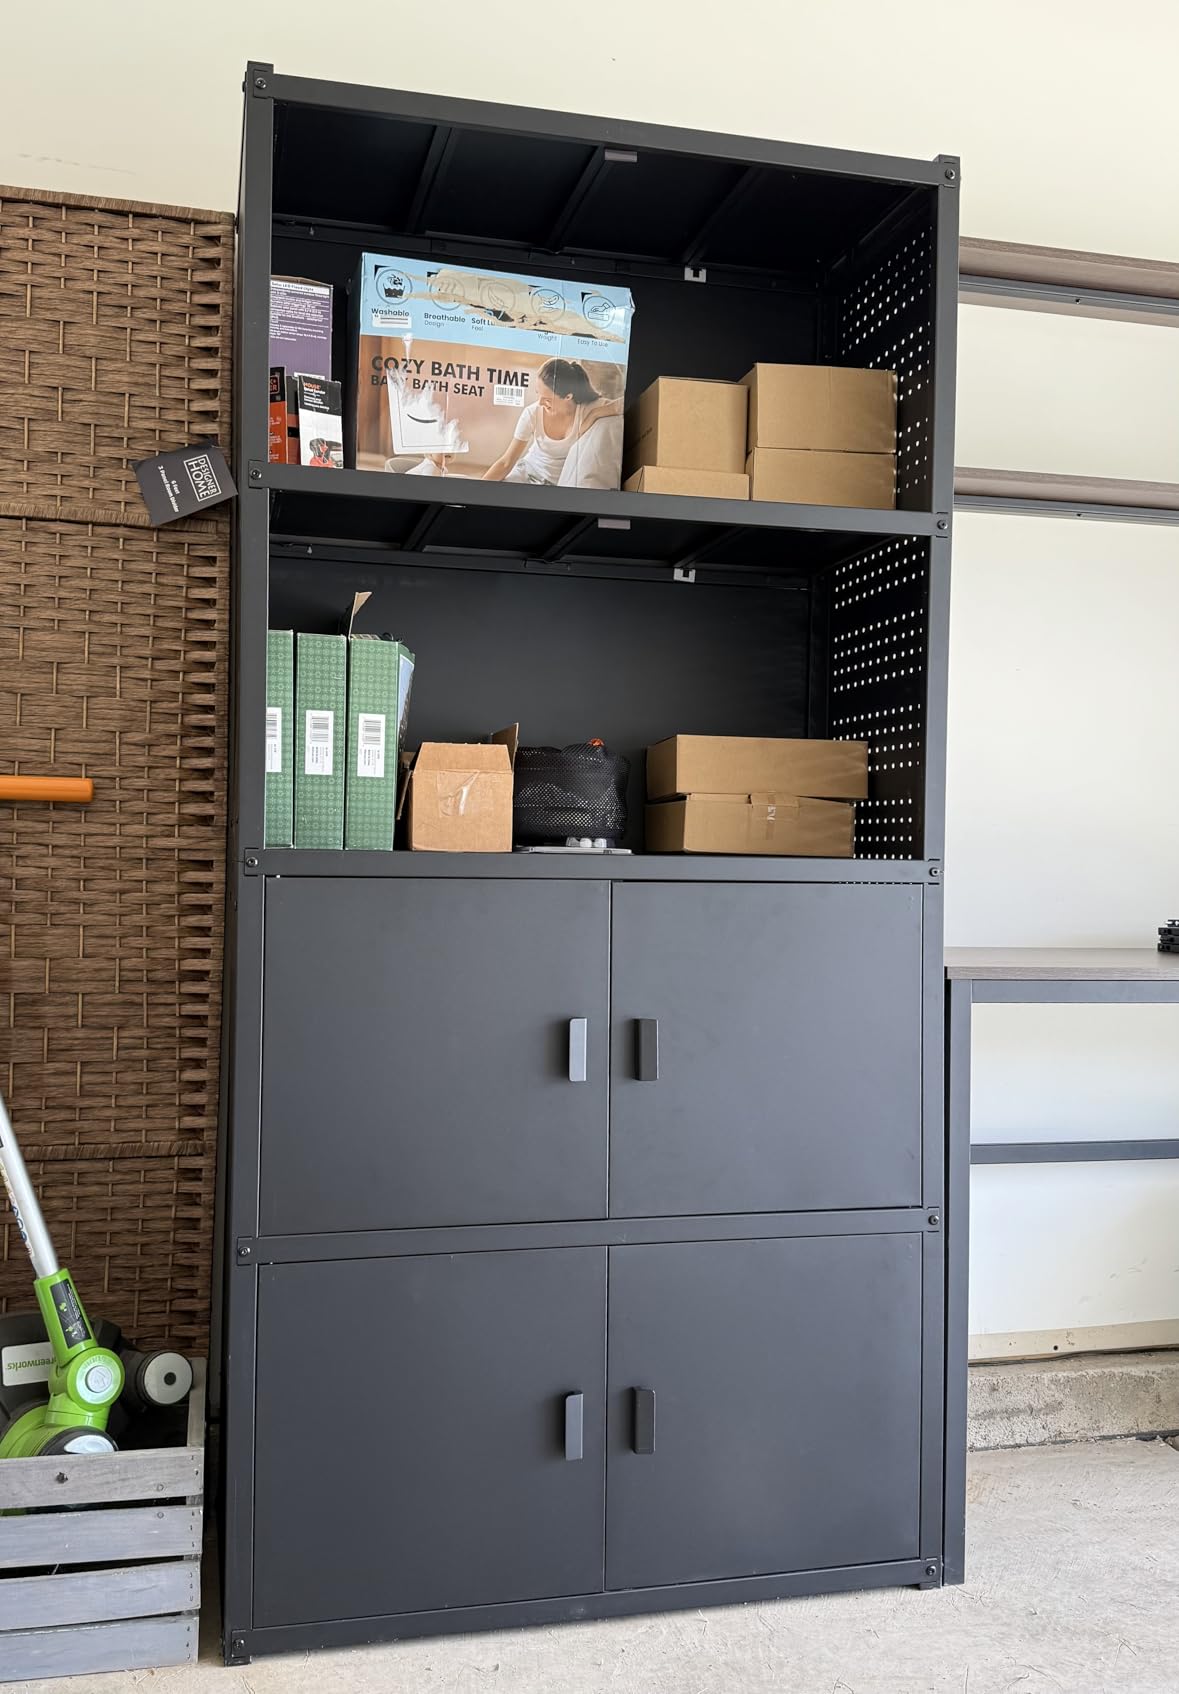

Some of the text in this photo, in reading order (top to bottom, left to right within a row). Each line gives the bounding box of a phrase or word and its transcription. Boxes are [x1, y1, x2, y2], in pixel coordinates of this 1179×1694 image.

[371, 308, 410, 317] Washable
[424, 312, 466, 323] Breathable
[424, 320, 445, 328] Design
[471, 317, 486, 326] Soft
[371, 355, 530, 388] COZY BATH TIME
[453, 382, 485, 398] SEAT
[187, 460, 211, 499] HOME
[198, 457, 217, 495] DESIGNER
